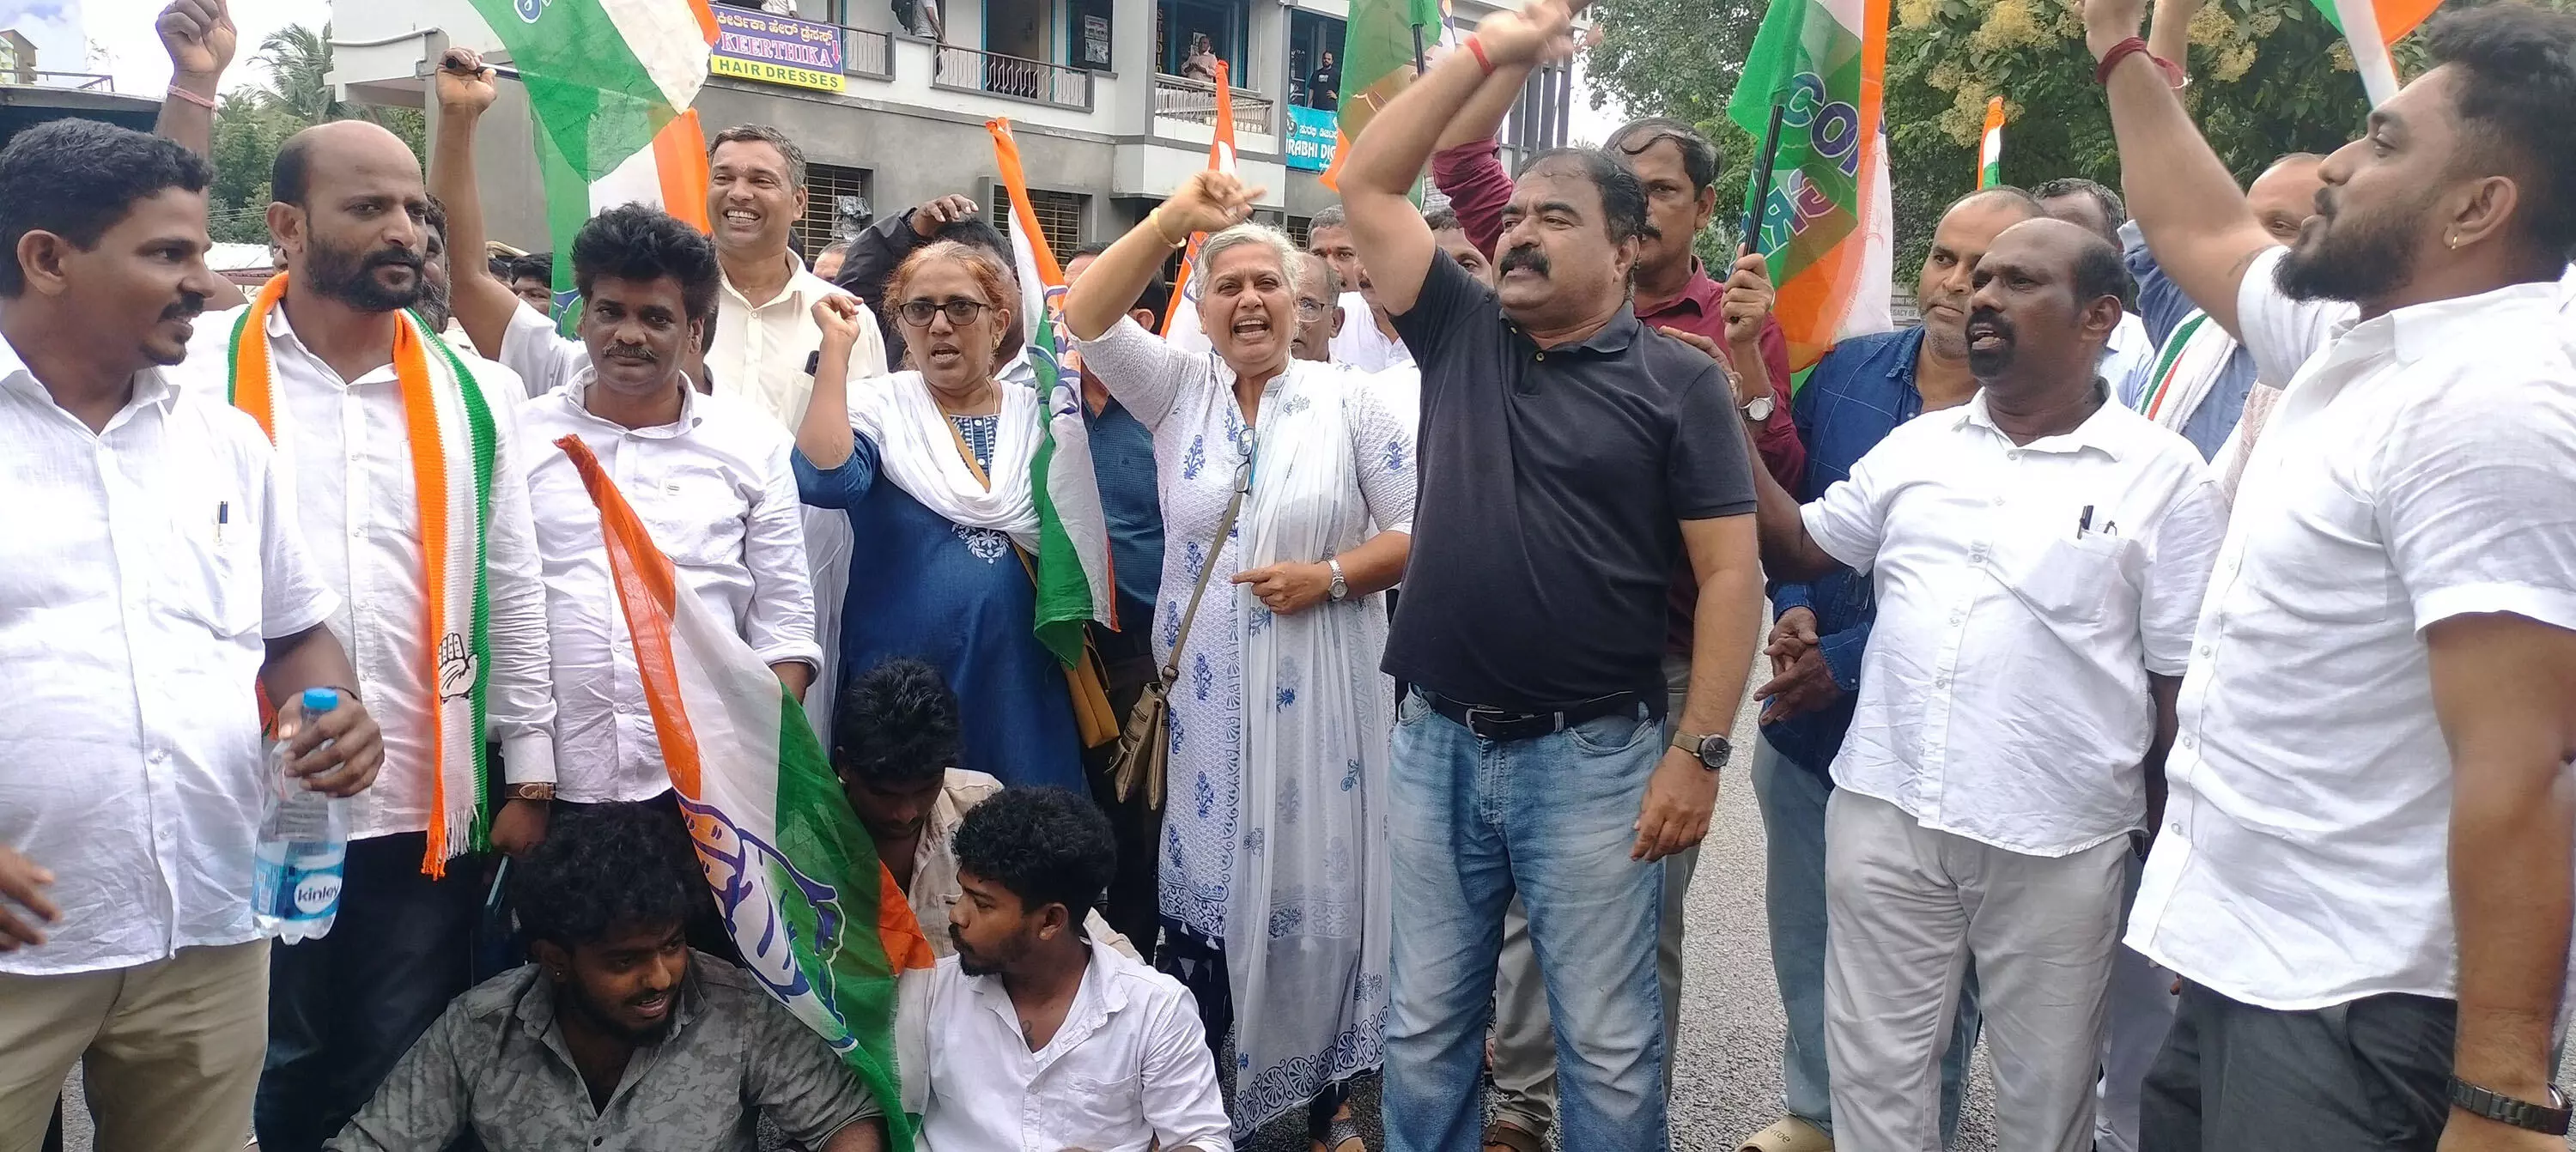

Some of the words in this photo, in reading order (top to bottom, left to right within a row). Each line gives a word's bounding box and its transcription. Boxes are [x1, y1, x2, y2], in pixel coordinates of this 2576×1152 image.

[721, 32, 833, 68] KEERTHIKA
[720, 59, 760, 76] HAIR
[766, 67, 838, 88] DRESSES
[297, 885, 338, 901] kinley
